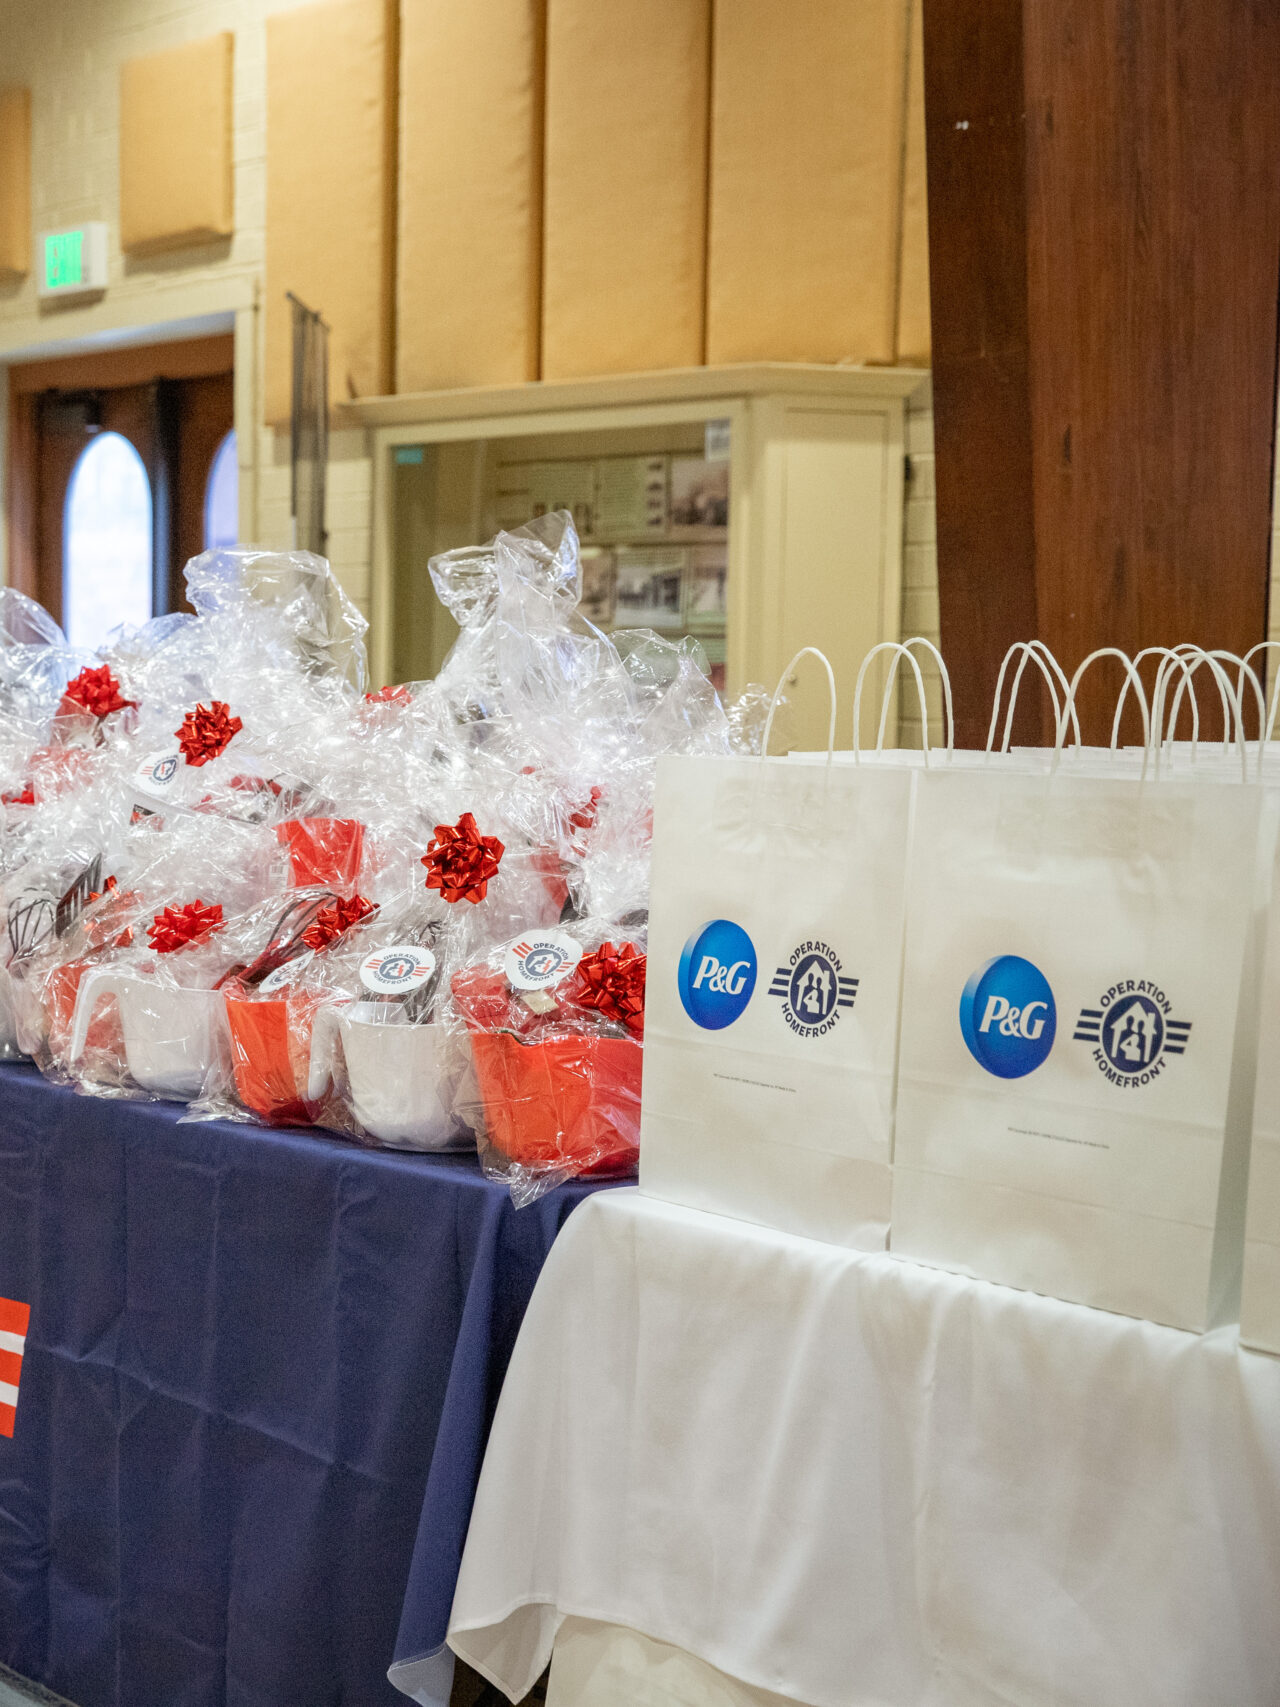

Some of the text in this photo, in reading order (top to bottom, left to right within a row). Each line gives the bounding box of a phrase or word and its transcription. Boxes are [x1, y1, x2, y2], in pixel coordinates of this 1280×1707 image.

[383, 952, 421, 966] OPERATION
[533, 943, 569, 961] OPERATION
[789, 940, 843, 972] OPERATION
[692, 955, 751, 995] P&G
[1100, 980, 1173, 1015] OPERATION
[781, 1002, 841, 1038] HOMEFRONT
[978, 995, 1048, 1040] P&G
[1092, 1048, 1167, 1088] HOMEFRONT
